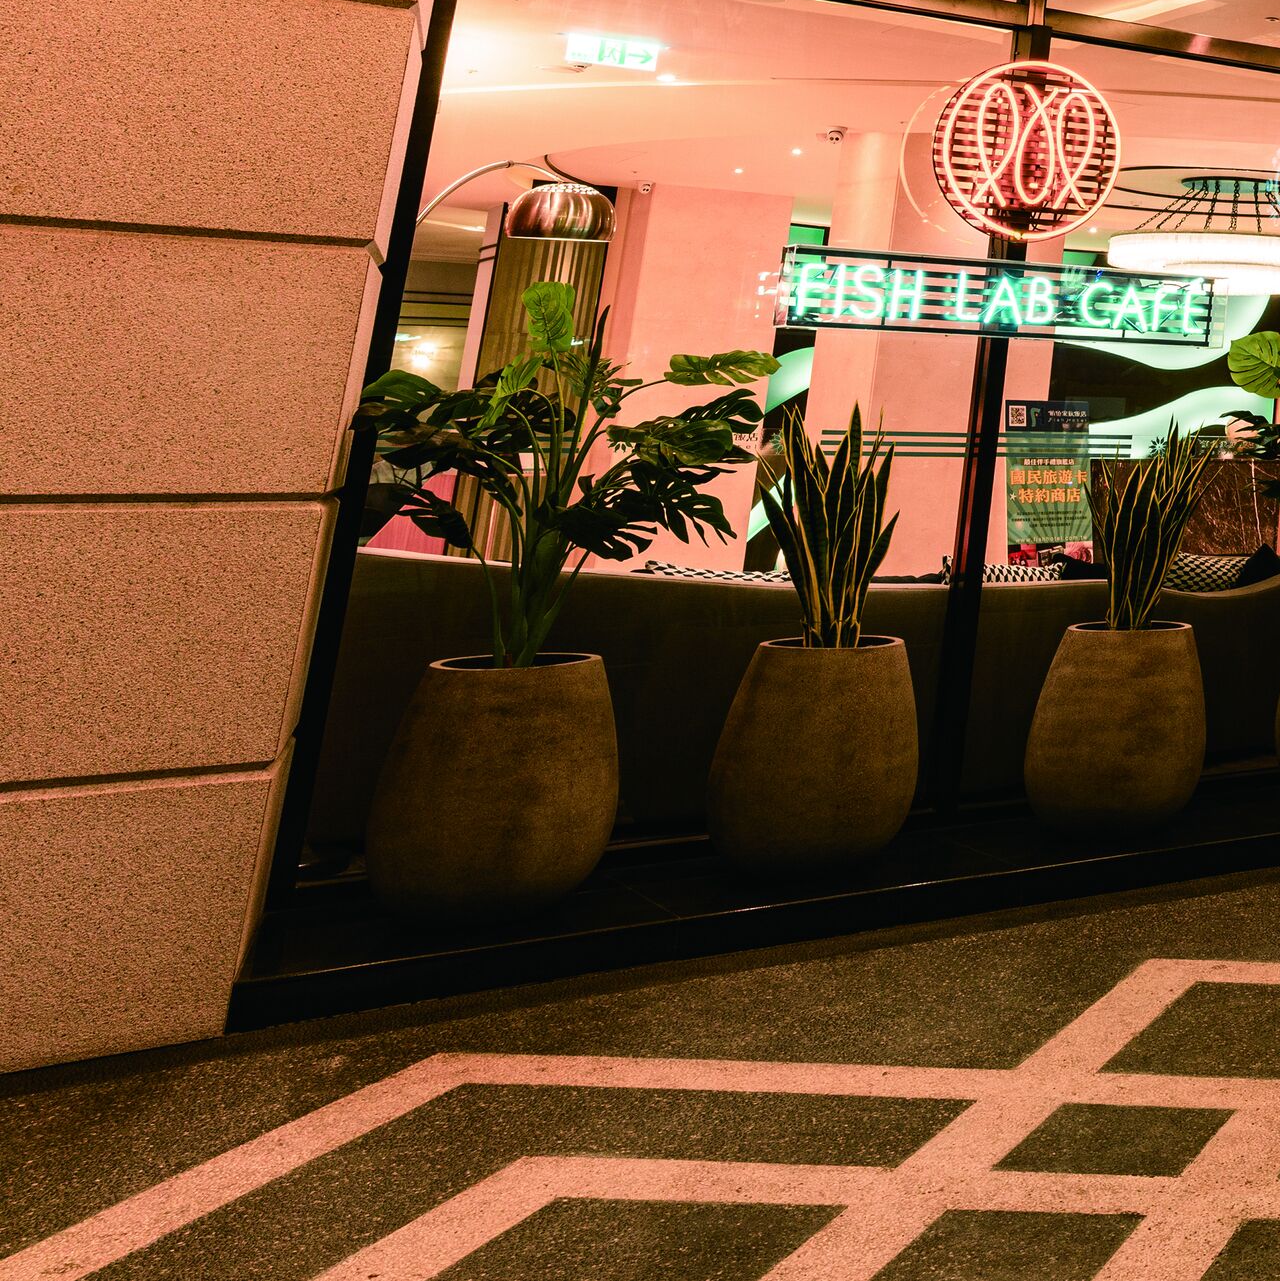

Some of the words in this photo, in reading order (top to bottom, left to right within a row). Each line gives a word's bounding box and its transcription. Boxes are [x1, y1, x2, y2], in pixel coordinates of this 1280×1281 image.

[795, 262, 923, 321] FISH
[956, 270, 1055, 325] LAB
[1010, 469, 1088, 485] 國民旅遊卡
[1018, 488, 1081, 503] 特約商店
